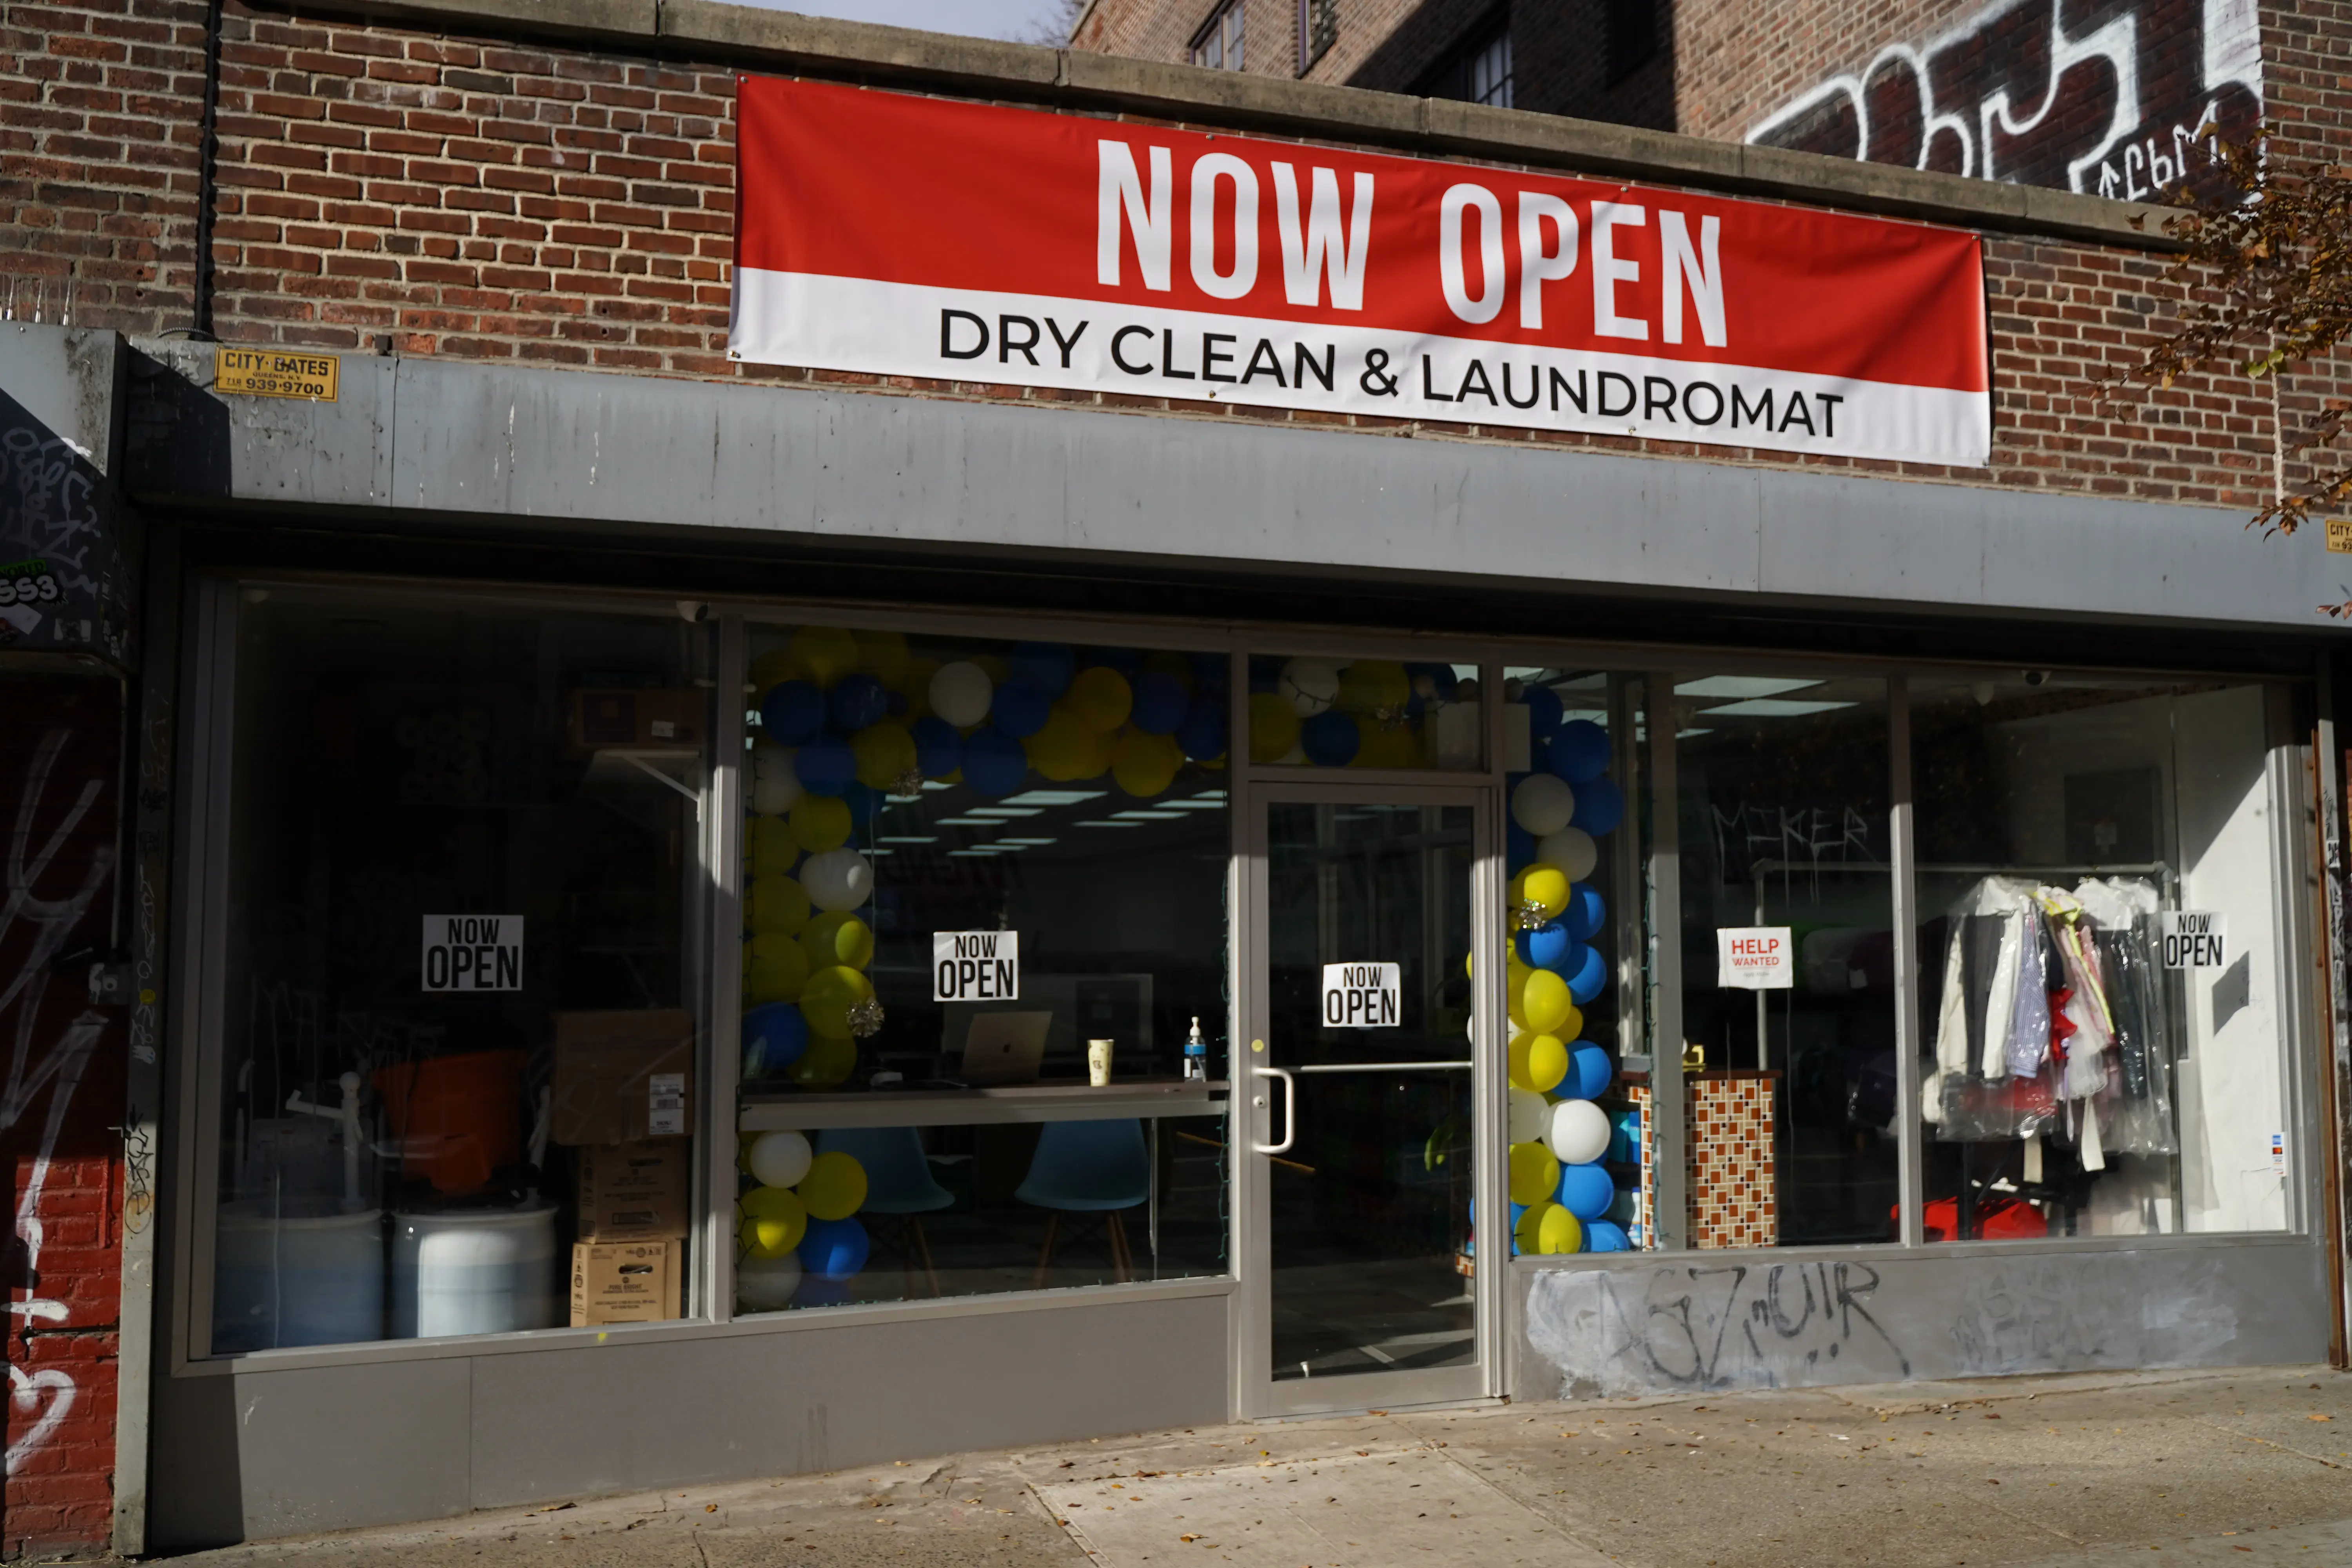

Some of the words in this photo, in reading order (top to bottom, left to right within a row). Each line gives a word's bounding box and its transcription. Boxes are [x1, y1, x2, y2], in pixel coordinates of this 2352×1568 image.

[1097, 138, 1374, 311] NOW
[1439, 182, 1727, 348] OPEN
[225, 353, 266, 370] CITY
[274, 357, 328, 376] GATES
[940, 309, 1089, 368] DRY
[1111, 325, 1335, 392] CLEAN
[1360, 348, 1399, 397] &
[1423, 354, 1844, 437] LAUNDROMAT
[2330, 524, 2350, 536] CITY
[448, 918, 499, 944] NOW
[2178, 914, 2211, 933] NOW
[955, 935, 997, 958] NOW
[1732, 939, 1779, 954] HELP
[2167, 934, 2222, 966] OPEN
[427, 945, 518, 989] OPEN
[1733, 956, 1779, 966] WANTED
[938, 959, 1013, 998] OPEN
[1344, 966, 1381, 987] NOW
[1327, 989, 1395, 1024] OPEN
